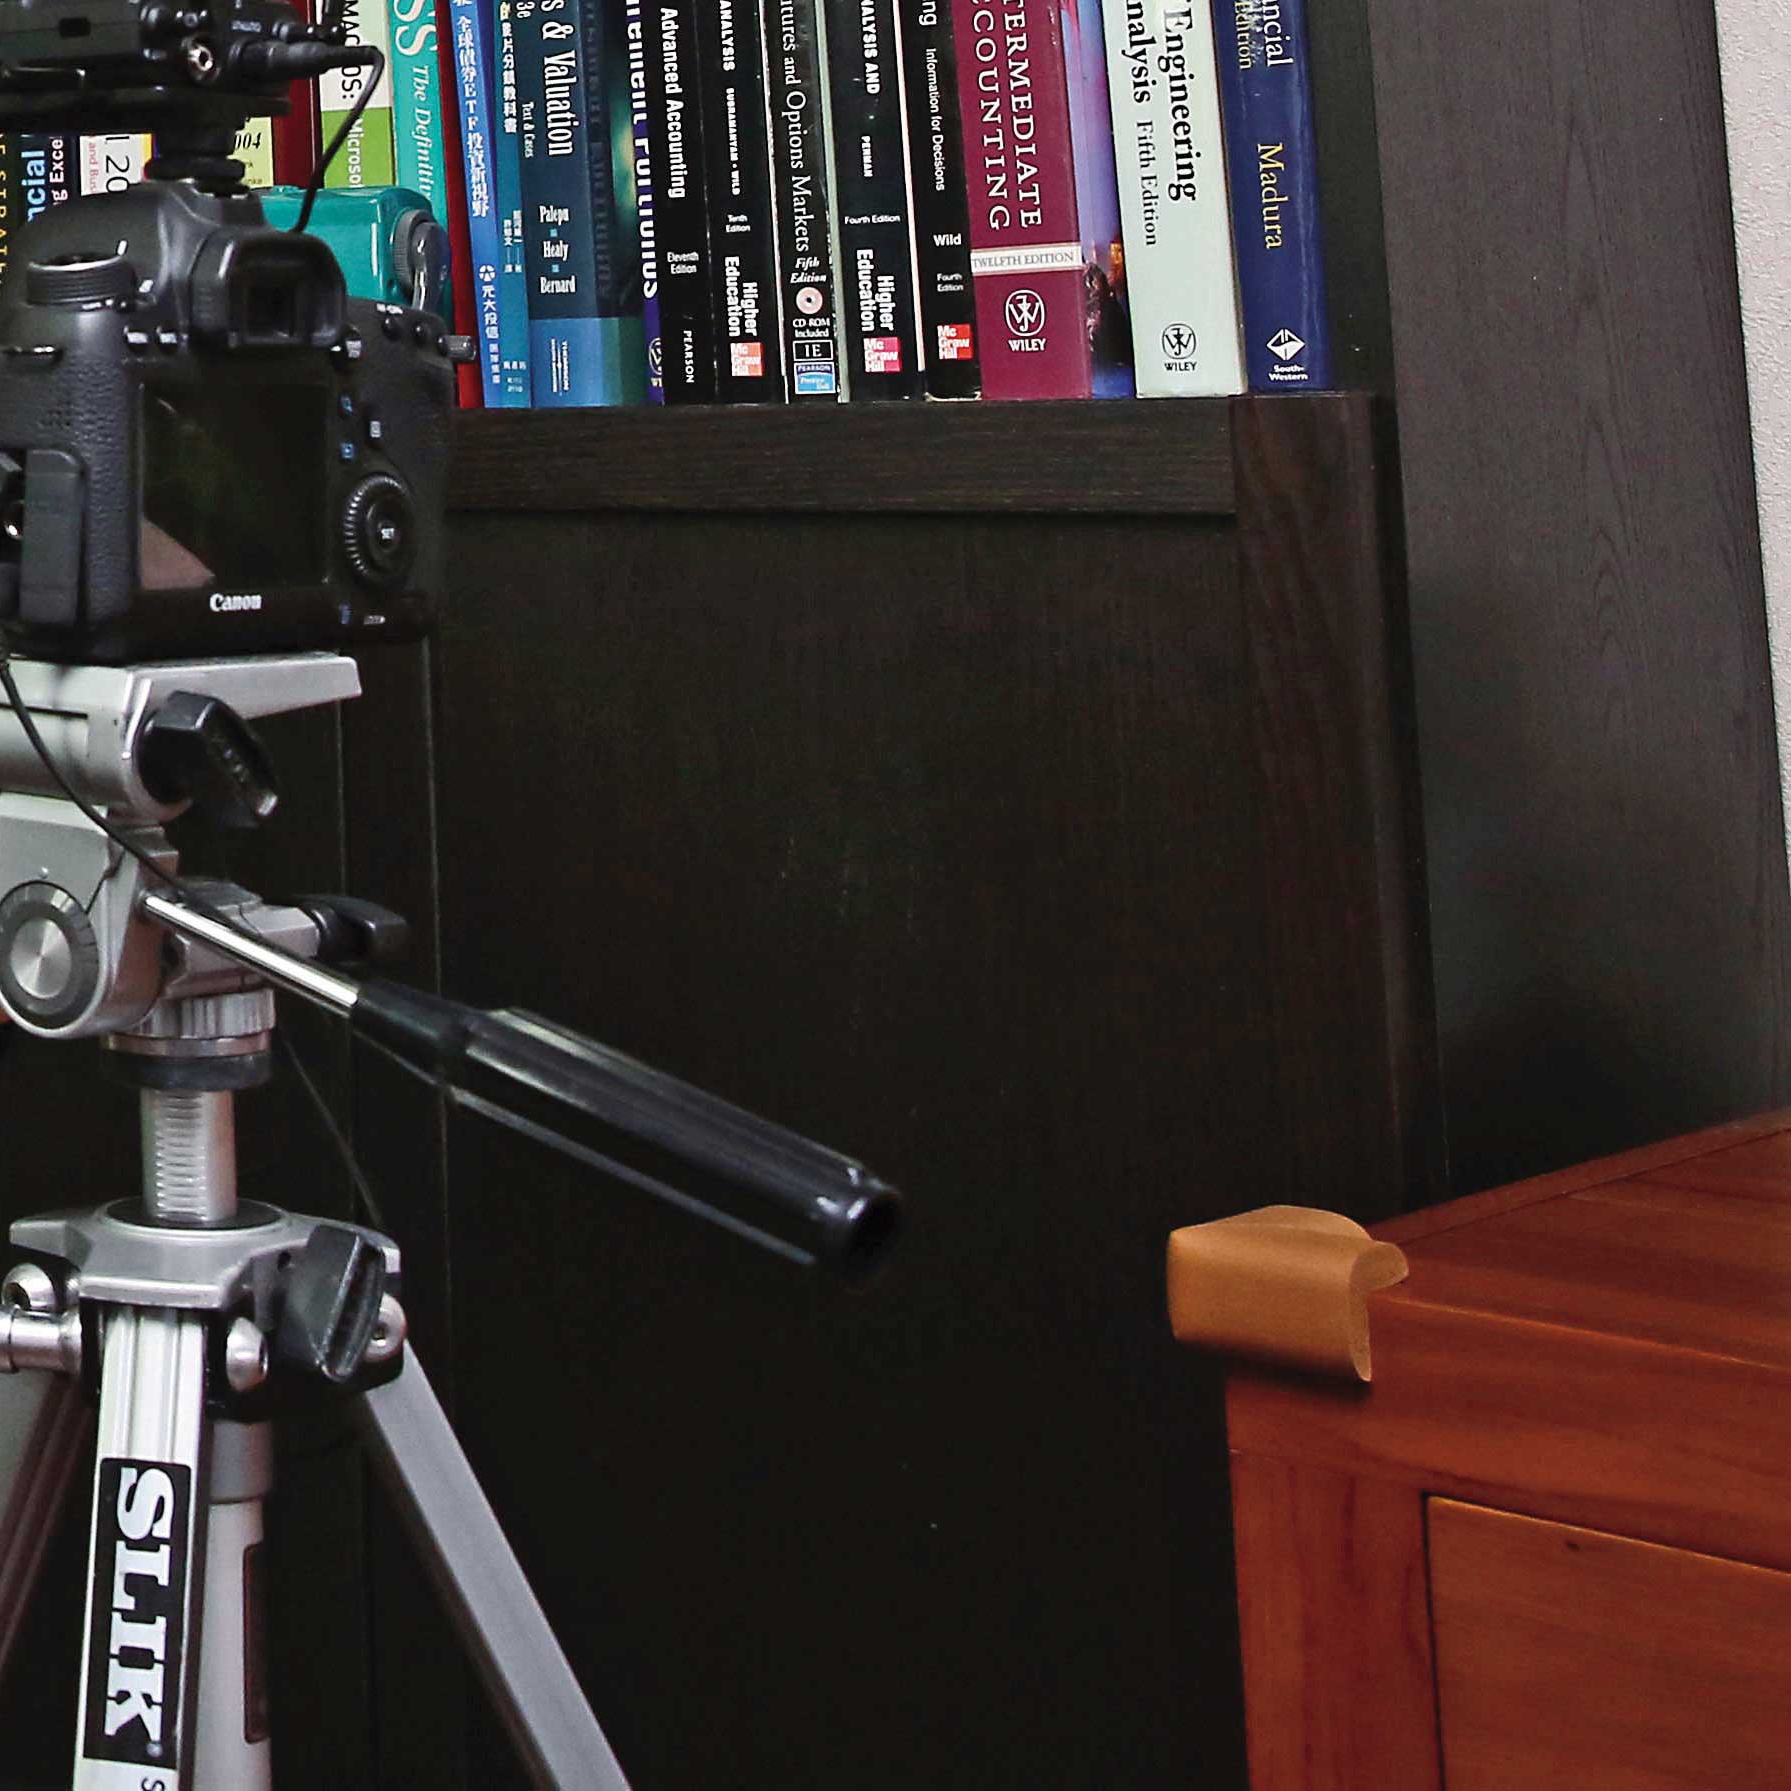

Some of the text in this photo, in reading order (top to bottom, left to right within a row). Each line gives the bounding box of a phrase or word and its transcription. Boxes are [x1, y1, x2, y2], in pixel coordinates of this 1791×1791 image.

[541, 21, 571, 41] &
[543, 50, 578, 157] Valuation
[925, 47, 945, 192] Information for Decisions
[860, 135, 873, 178] PENMAN
[1136, 121, 1157, 174] Fifth
[1255, 142, 1289, 251] Madura
[539, 205, 570, 225] Palepu
[844, 214, 901, 226] Fourth Edition
[1140, 176, 1161, 247] Edition
[932, 233, 962, 247] Wild
[543, 240, 569, 261] Healy
[971, 250, 1075, 271] TWELFTH EDITION
[794, 257, 820, 269] Fifth
[540, 276, 576, 293] Bernard
[789, 272, 827, 285] Edition
[936, 272, 963, 282] Fourth
[936, 282, 964, 293] Edition
[1007, 338, 1047, 353] WILEY
[683, 330, 695, 384] PEARSON
[1164, 360, 1197, 373] WILEY
[208, 590, 263, 613] Canon
[104, 1466, 177, 1743] SLIK
